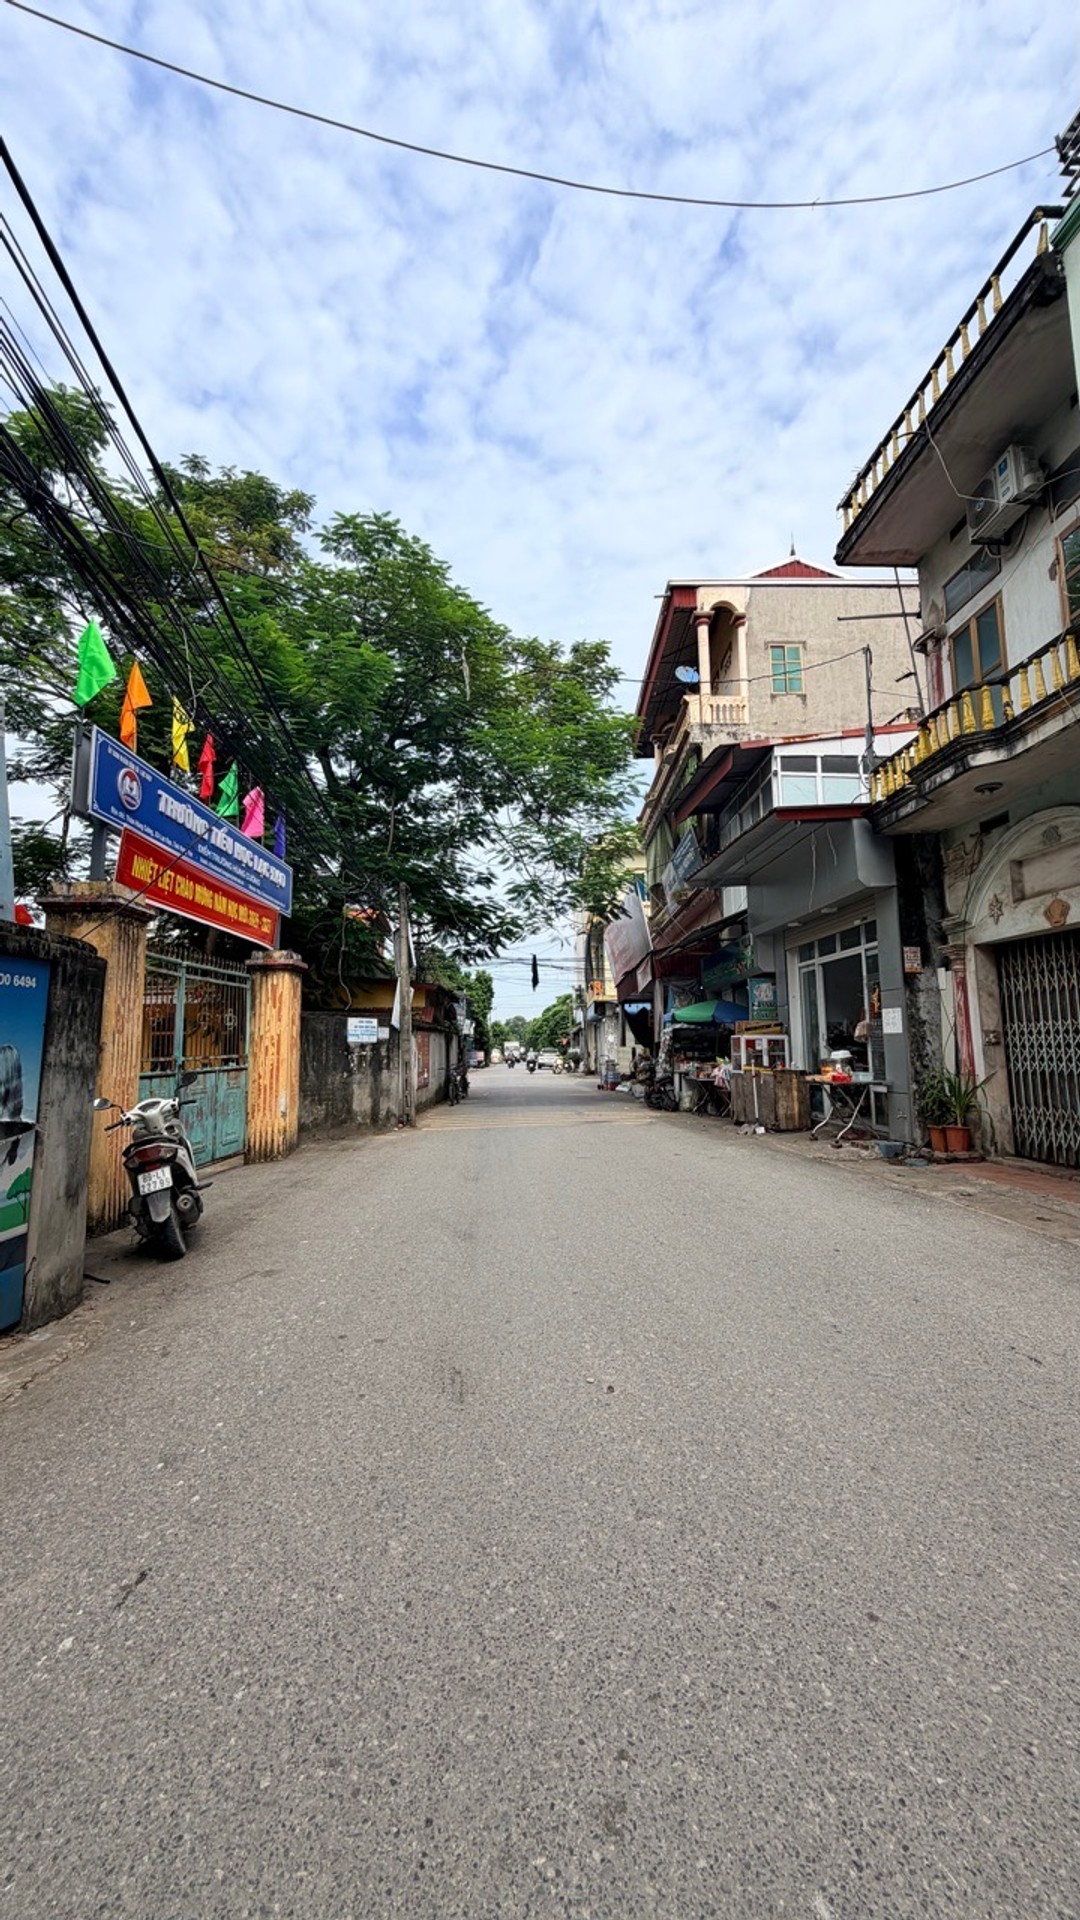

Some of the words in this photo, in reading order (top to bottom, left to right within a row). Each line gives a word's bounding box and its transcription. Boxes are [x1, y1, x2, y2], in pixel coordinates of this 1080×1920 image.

[158, 789, 209, 840] TRƯỜNG
[233, 842, 254, 868] HỌC
[13, 974, 36, 988] 6494
